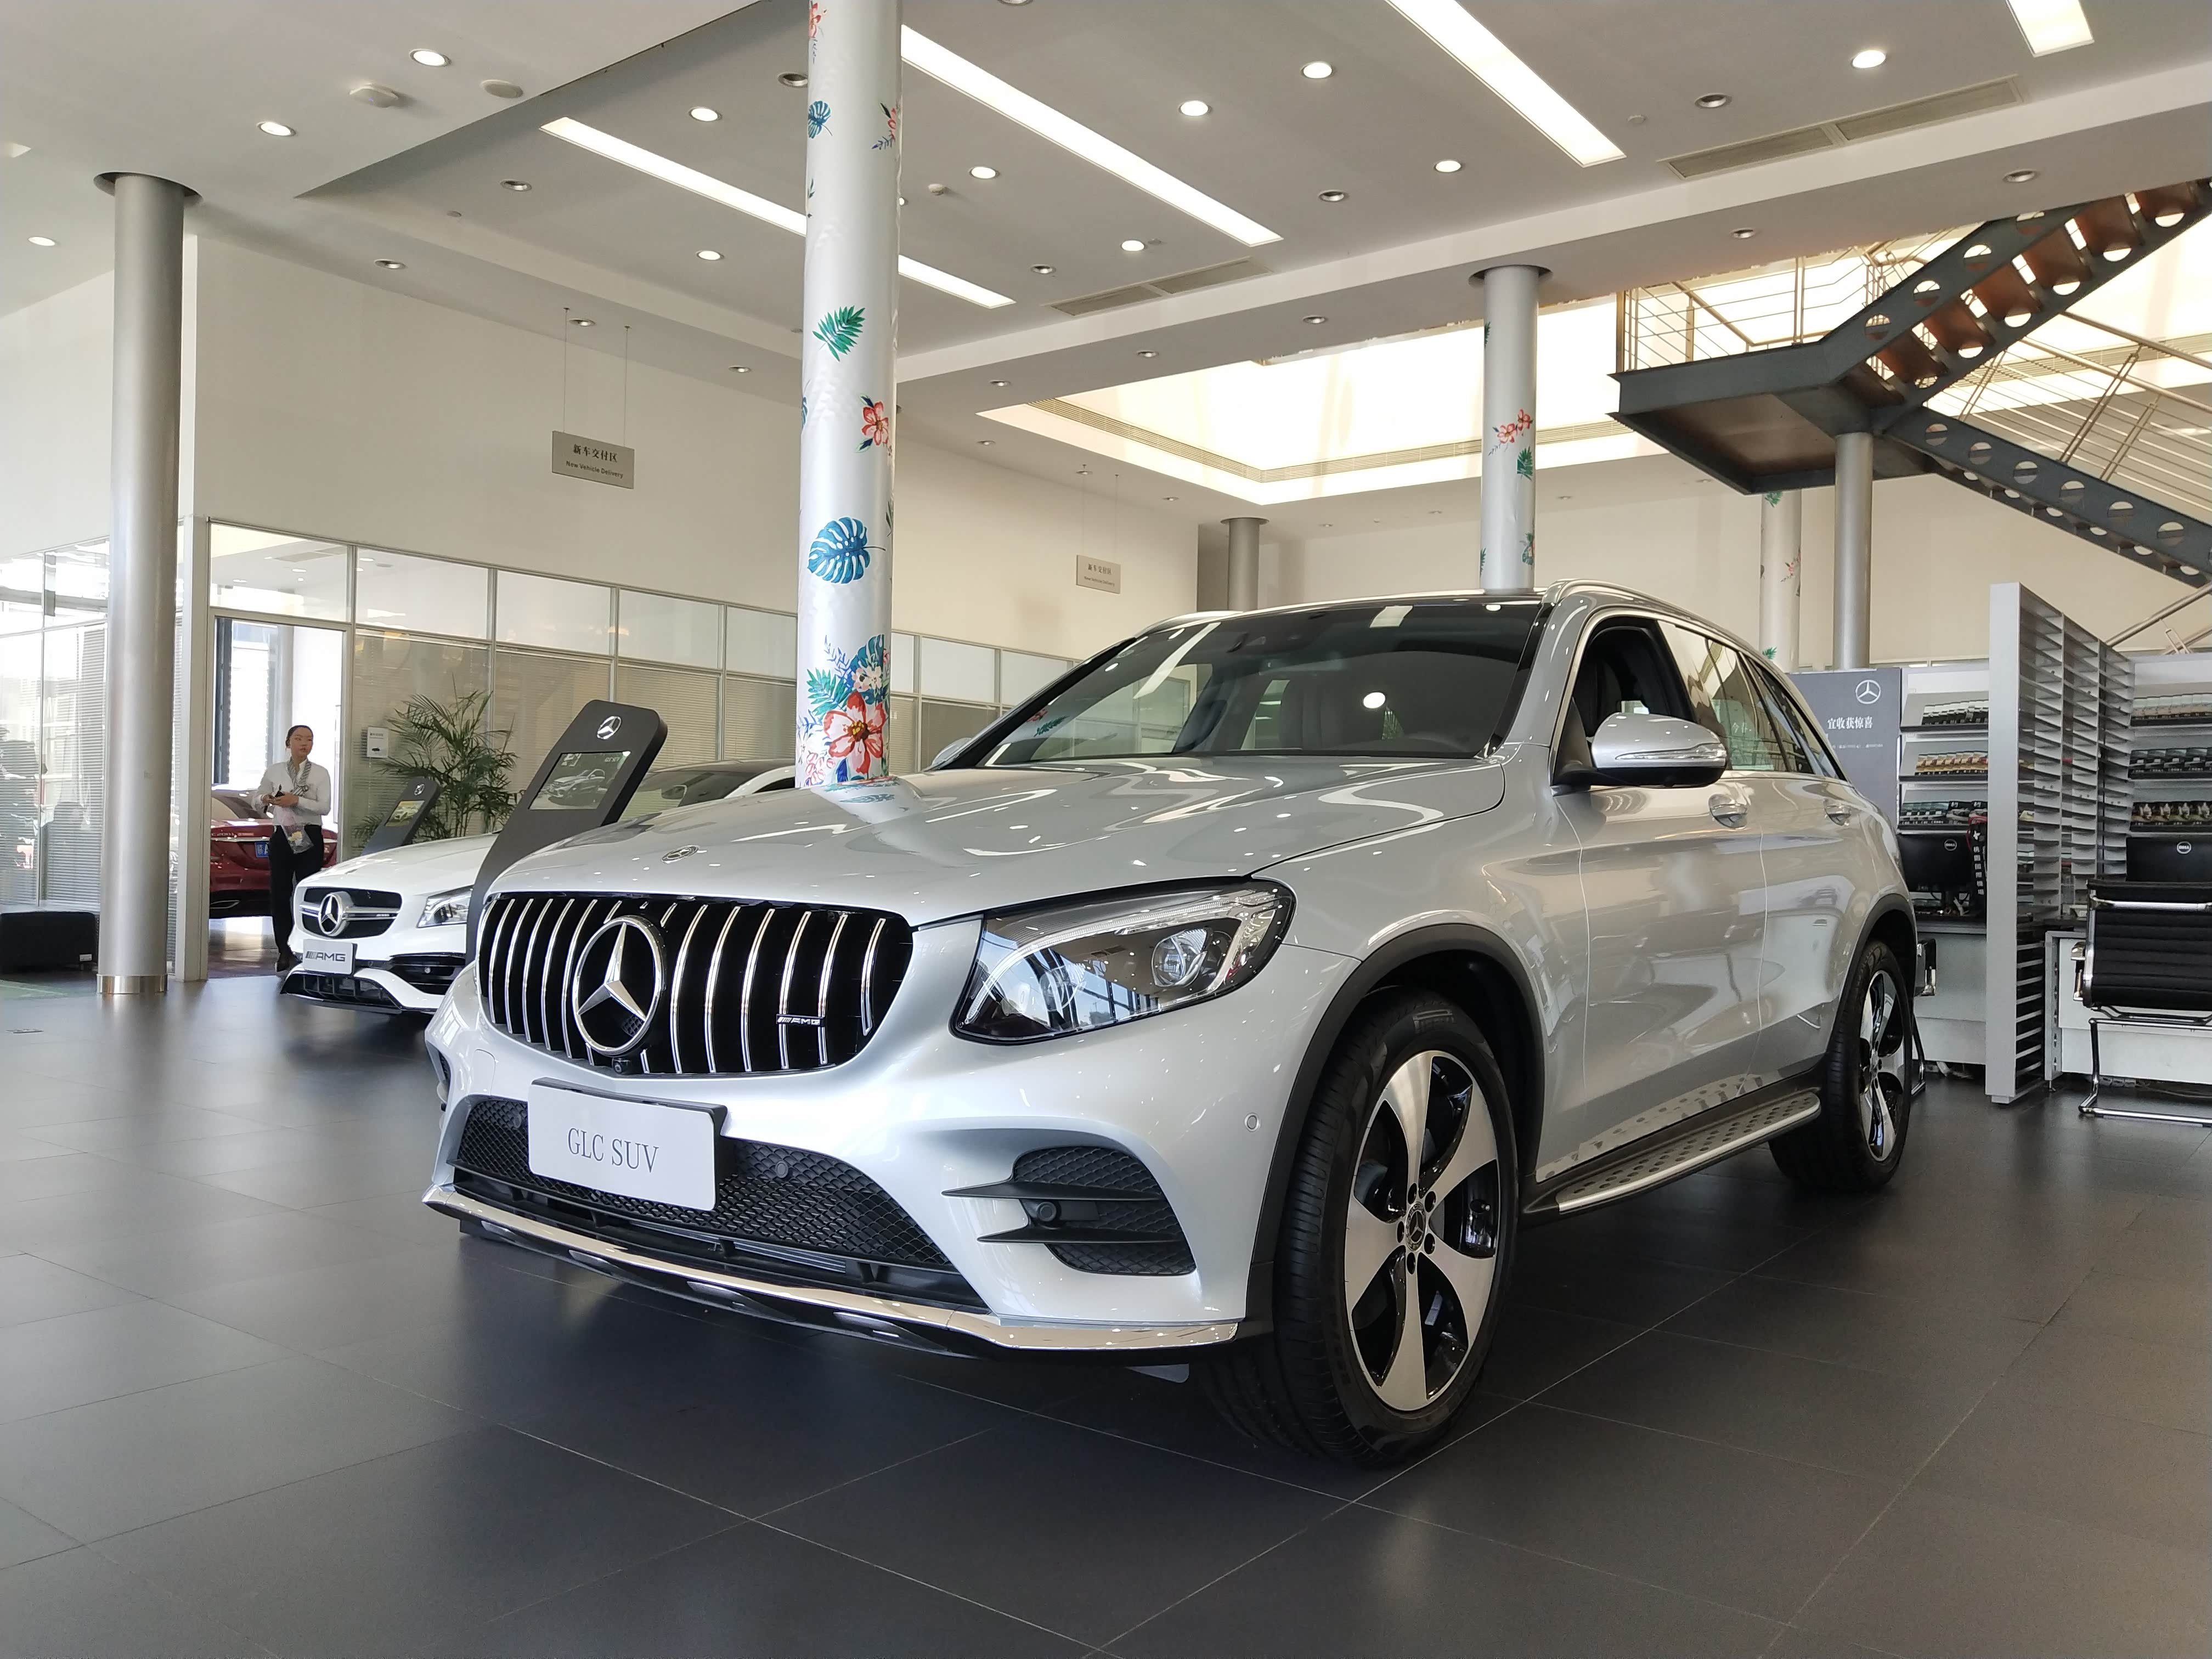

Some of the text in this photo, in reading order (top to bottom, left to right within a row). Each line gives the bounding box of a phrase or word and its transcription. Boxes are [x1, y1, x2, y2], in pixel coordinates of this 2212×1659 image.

[573, 443, 618, 463] 新车交付区
[566, 460, 624, 479] New Vehicle Delivery
[1827, 715, 1873, 730] 宜收获惊喜
[316, 952, 346, 962] AMG
[567, 1127, 659, 1173] GLC SUV
